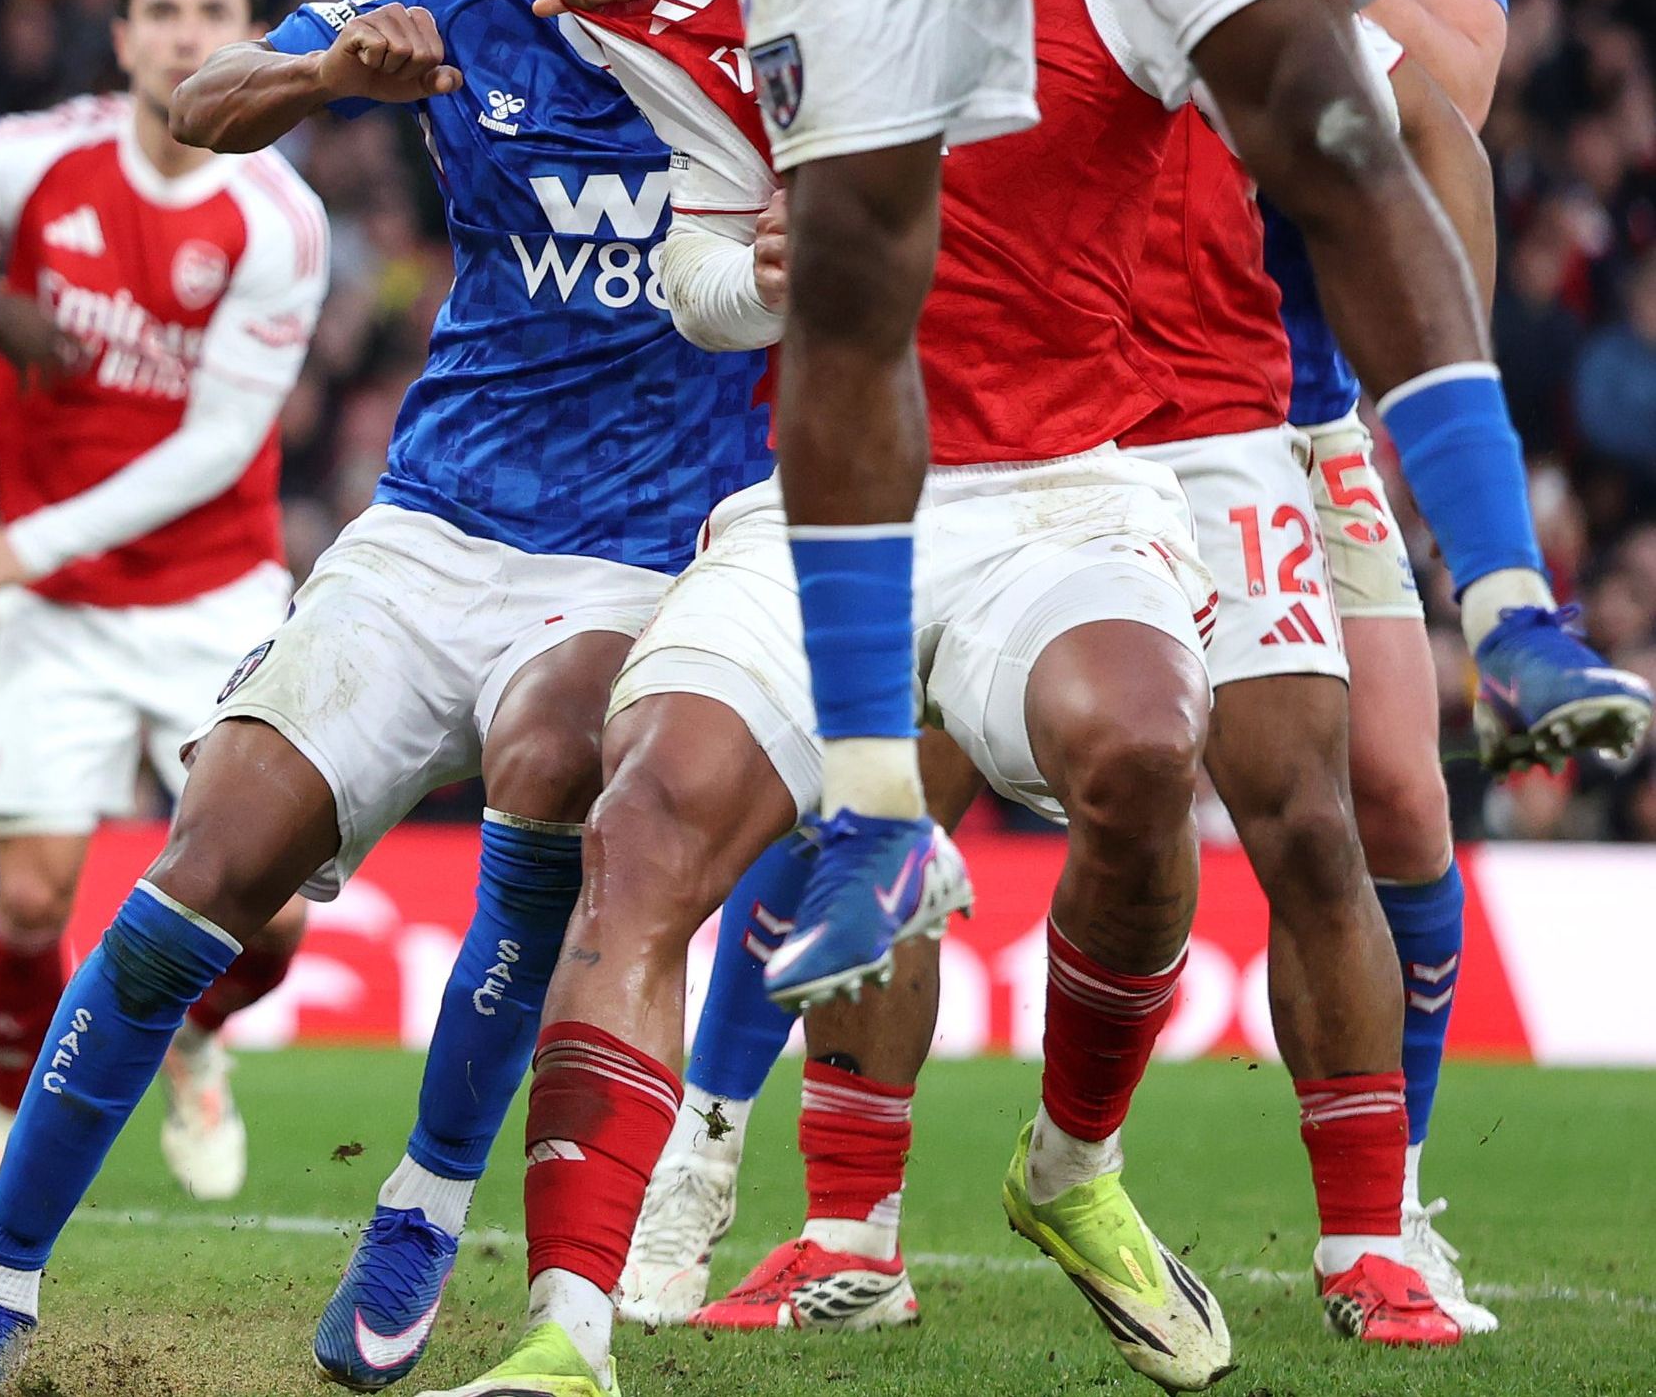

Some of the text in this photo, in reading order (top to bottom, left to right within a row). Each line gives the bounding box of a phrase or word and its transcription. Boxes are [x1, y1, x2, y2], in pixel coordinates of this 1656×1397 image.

[477, 110, 520, 137] hummel
[1319, 452, 1390, 545] 5
[1228, 504, 1321, 598] 12
[471, 938, 521, 1016] SAFC
[42, 1007, 93, 1095] SAFC
